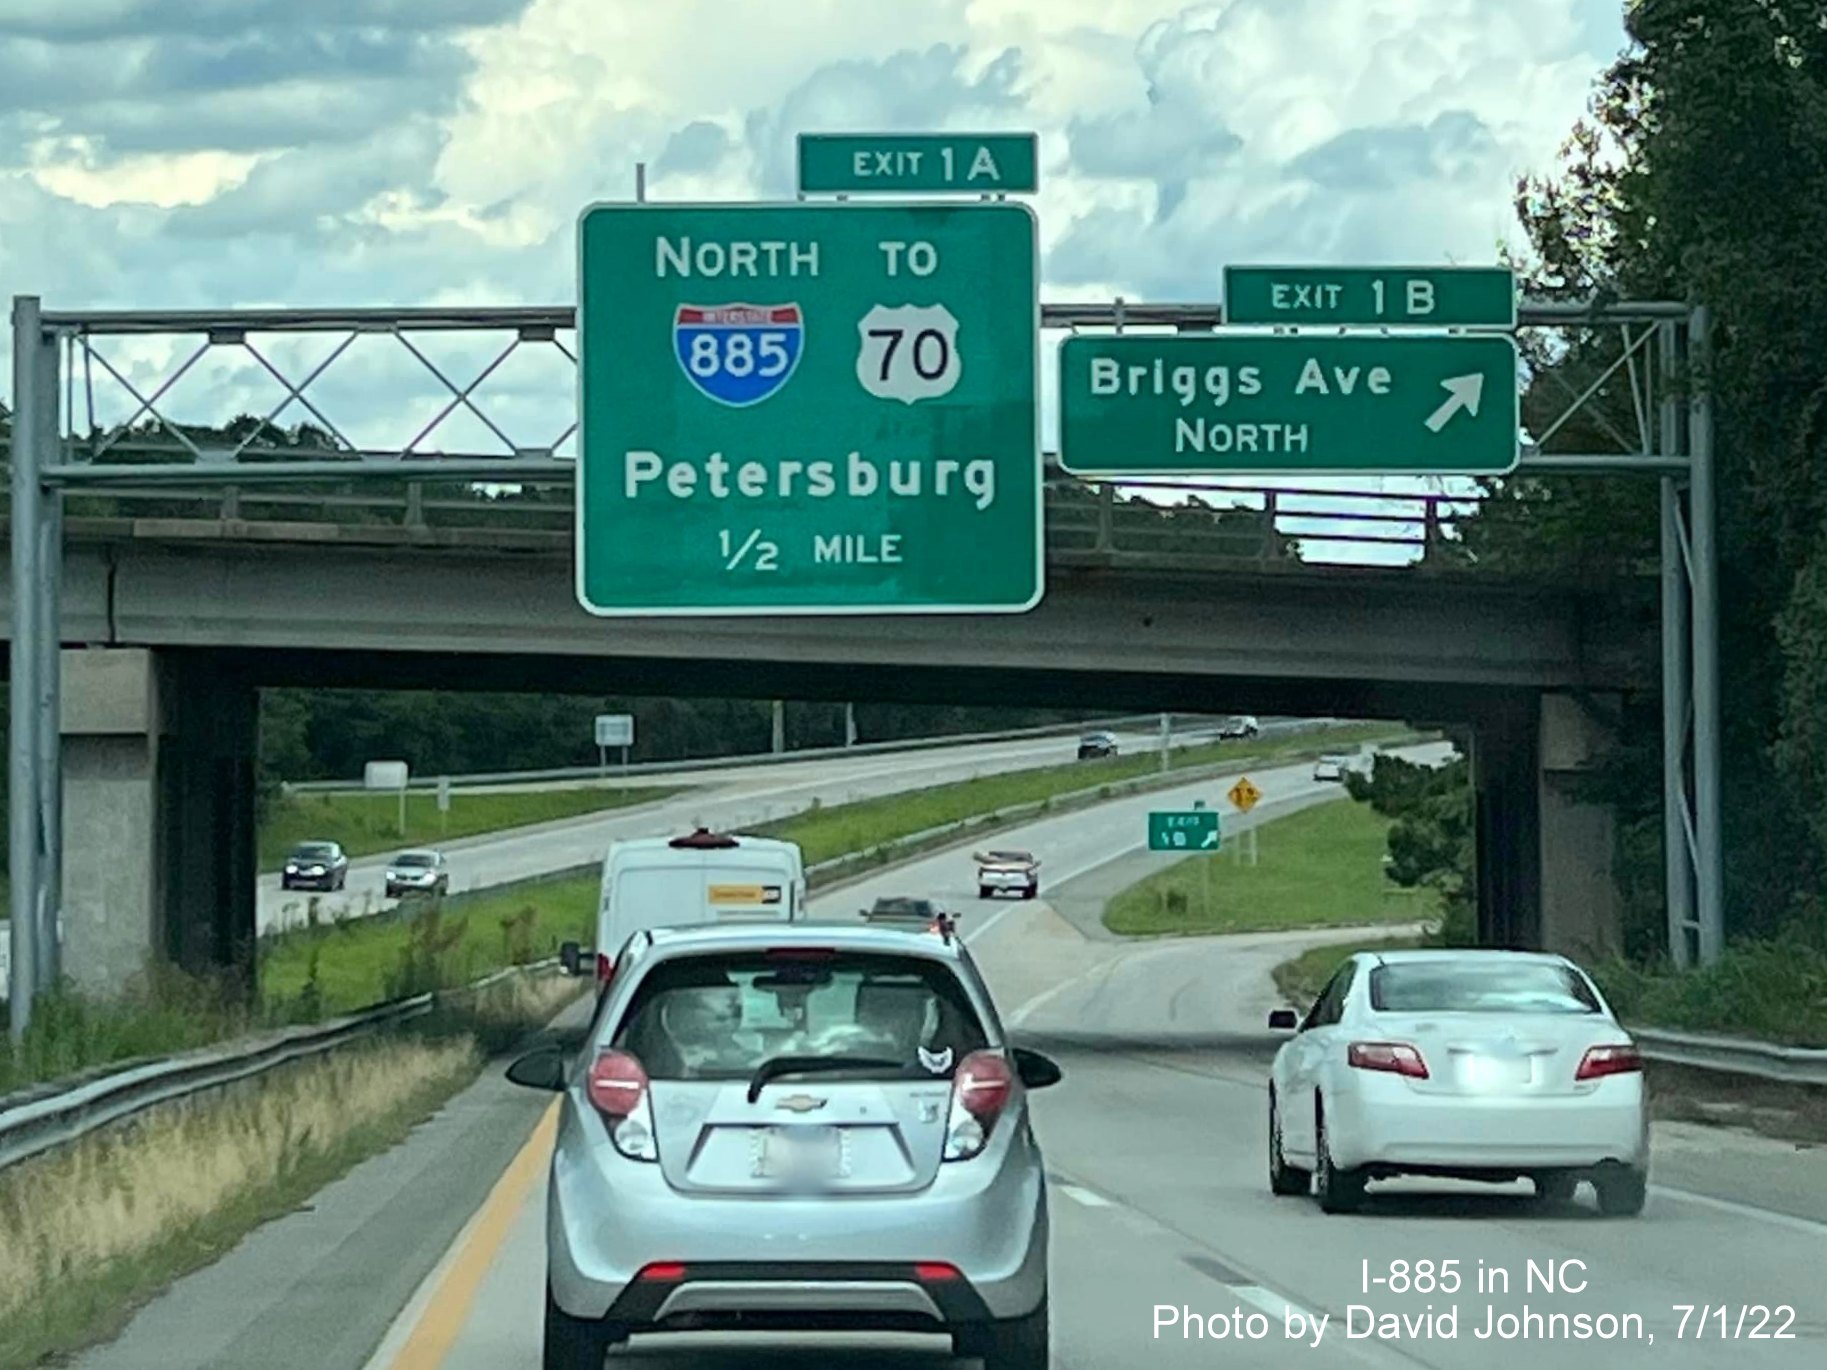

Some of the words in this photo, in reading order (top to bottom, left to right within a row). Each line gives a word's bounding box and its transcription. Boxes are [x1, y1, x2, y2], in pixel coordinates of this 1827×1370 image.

[853, 151, 923, 176] EXIT
[655, 236, 819, 277] NORTH
[878, 241, 938, 276] TO
[1271, 284, 1343, 309] EXIT
[689, 333, 789, 378] 885
[867, 328, 949, 382] 70
[1091, 358, 1263, 407] Briggs
[1295, 358, 1392, 395] Ave
[1175, 417, 1309, 453] NORTH
[624, 451, 995, 511] Petersburg
[813, 534, 903, 563] MILE
